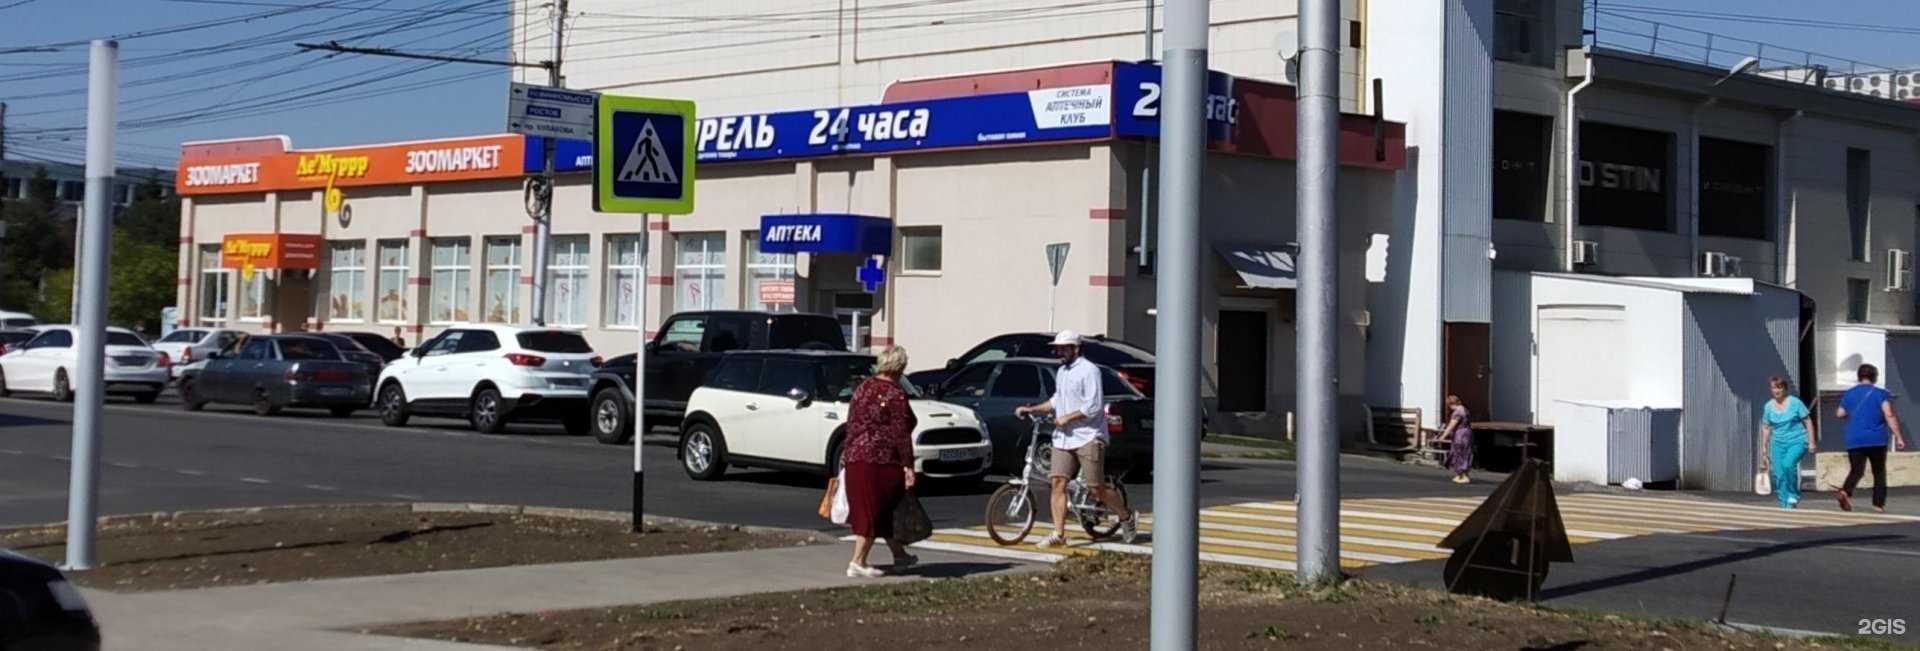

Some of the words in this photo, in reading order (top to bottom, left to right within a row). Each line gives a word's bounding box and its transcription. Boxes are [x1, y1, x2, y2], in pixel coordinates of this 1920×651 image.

[1045, 96, 1103, 112] АПТЕЧНЫЙ
[1056, 88, 1092, 98] СИСТЕМА
[1133, 82, 1160, 117] 2
[808, 108, 850, 145] 24
[857, 108, 930, 141] часа
[1060, 113, 1086, 124] КЛУБ
[695, 116, 775, 151] РЕЛЬ
[405, 144, 503, 173] ЗООМАРКЕТ
[185, 162, 260, 186] ЗООМАРКЕТ
[766, 224, 822, 242] АПТЕКА
